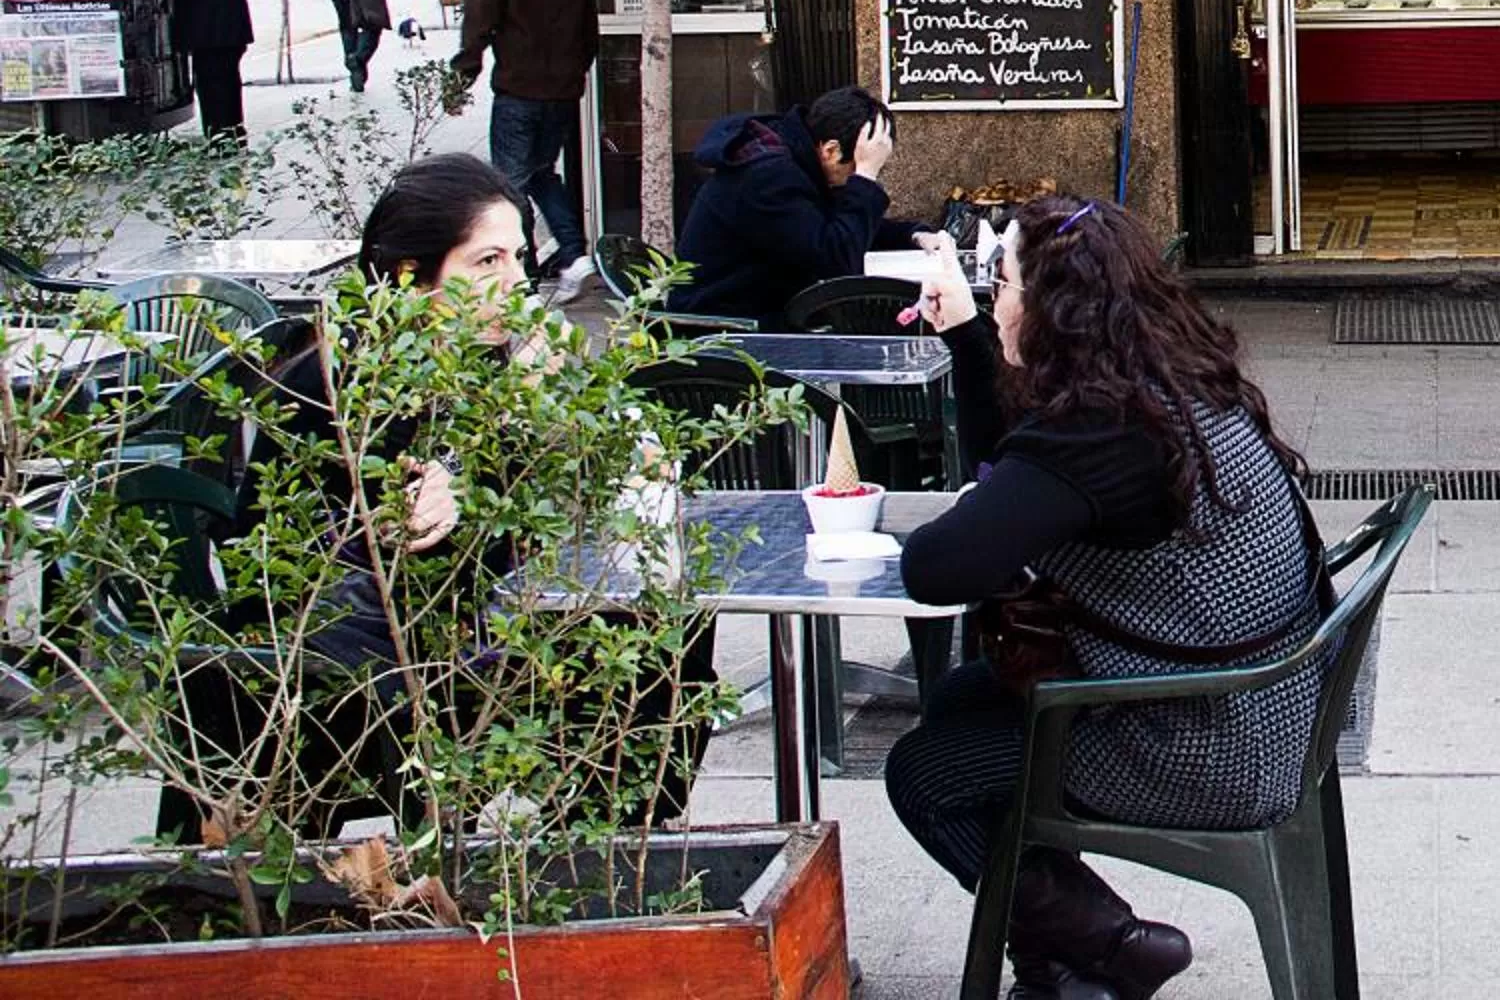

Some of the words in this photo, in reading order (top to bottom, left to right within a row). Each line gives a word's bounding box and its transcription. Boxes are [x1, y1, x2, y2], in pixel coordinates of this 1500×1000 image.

[897, 31, 985, 55] Lasaña
[897, 57, 985, 85] Lasaña
[989, 60, 1083, 85] Verduras
